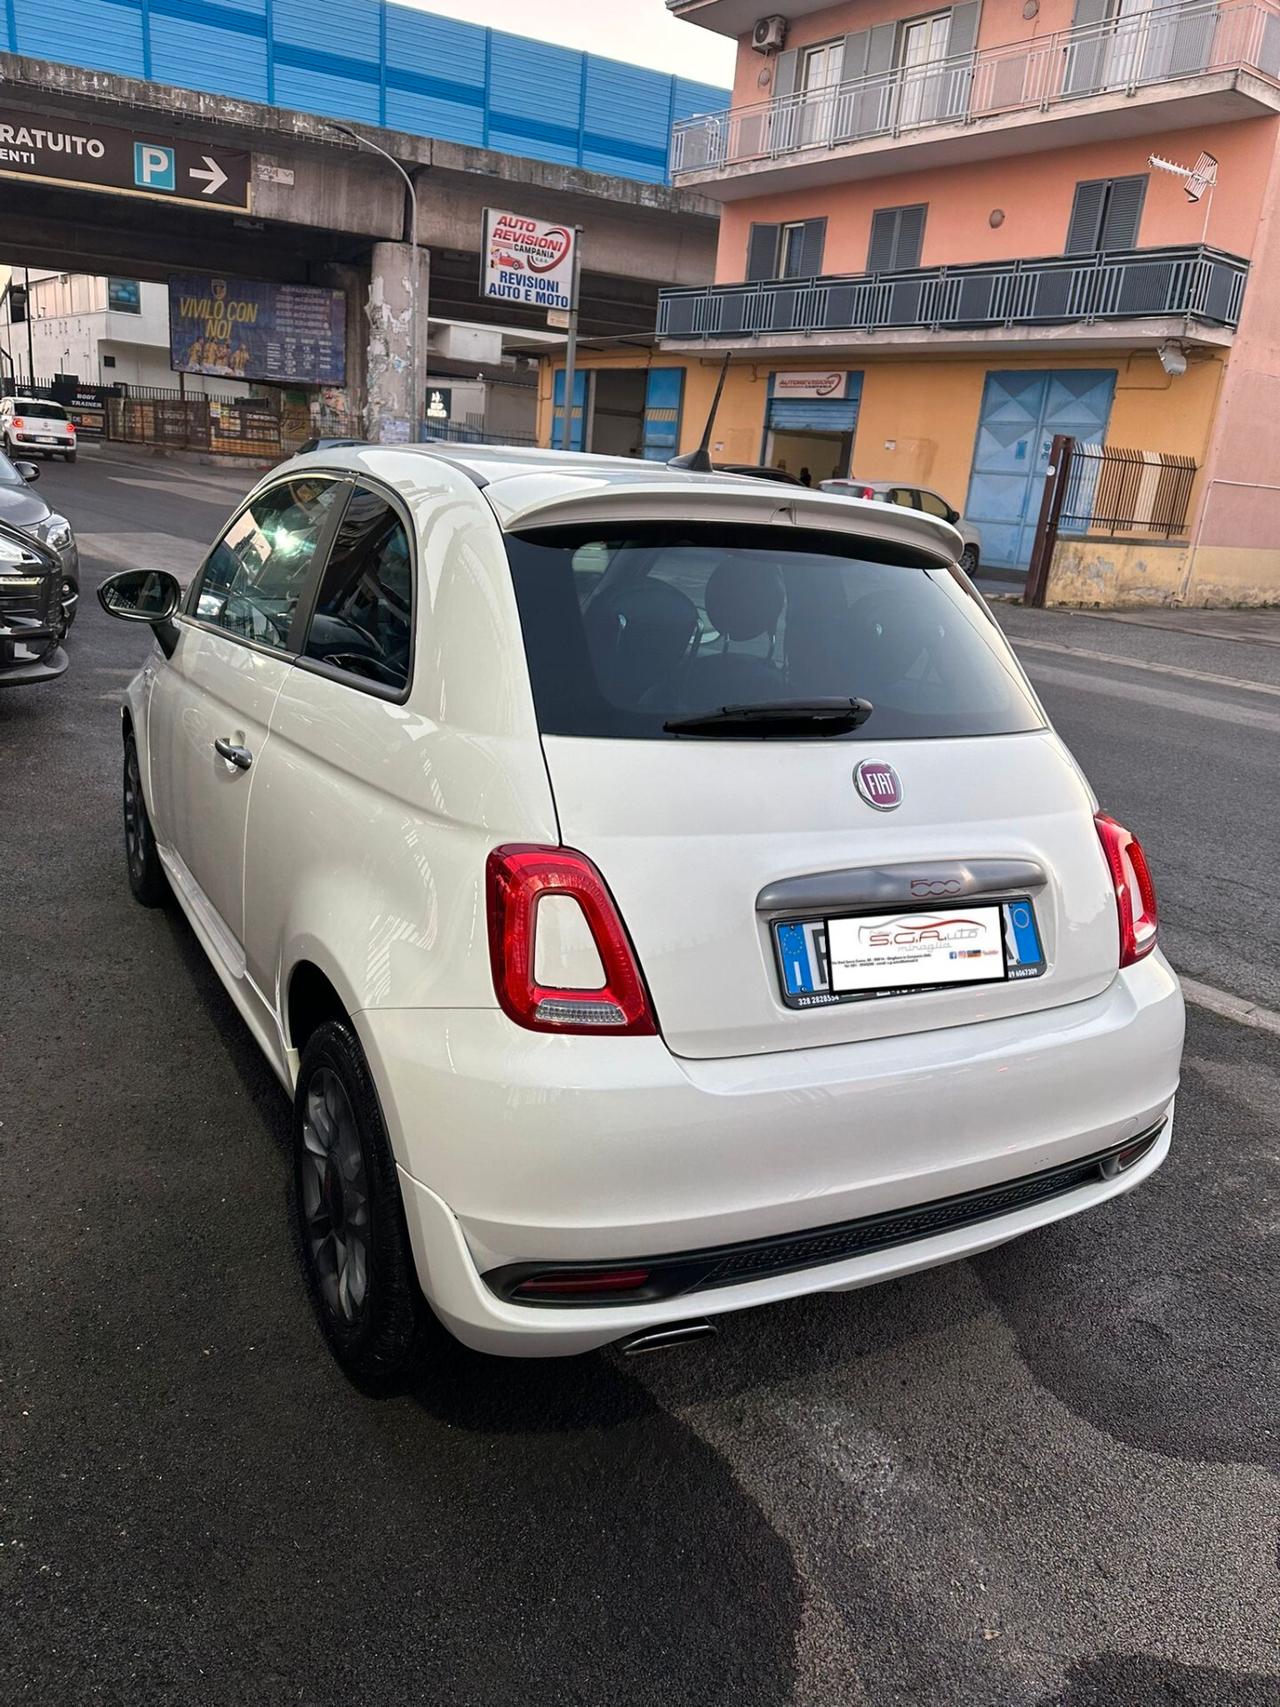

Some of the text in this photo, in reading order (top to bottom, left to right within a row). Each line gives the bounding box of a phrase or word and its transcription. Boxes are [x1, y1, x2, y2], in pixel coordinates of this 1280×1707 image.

[497, 215, 536, 233] AUTO
[492, 228, 563, 252] REVISIONI
[513, 243, 555, 259] CAMPANIA
[499, 270, 559, 293] REVISIONI
[488, 283, 569, 308] AUTO E MOTO
[179, 297, 224, 320] VIVILO
[226, 301, 259, 323] CON
[205, 319, 233, 339] NOI
[71, 400, 103, 408] TRAINER
[866, 773, 895, 795] FIAT
[910, 878, 961, 897] 500
